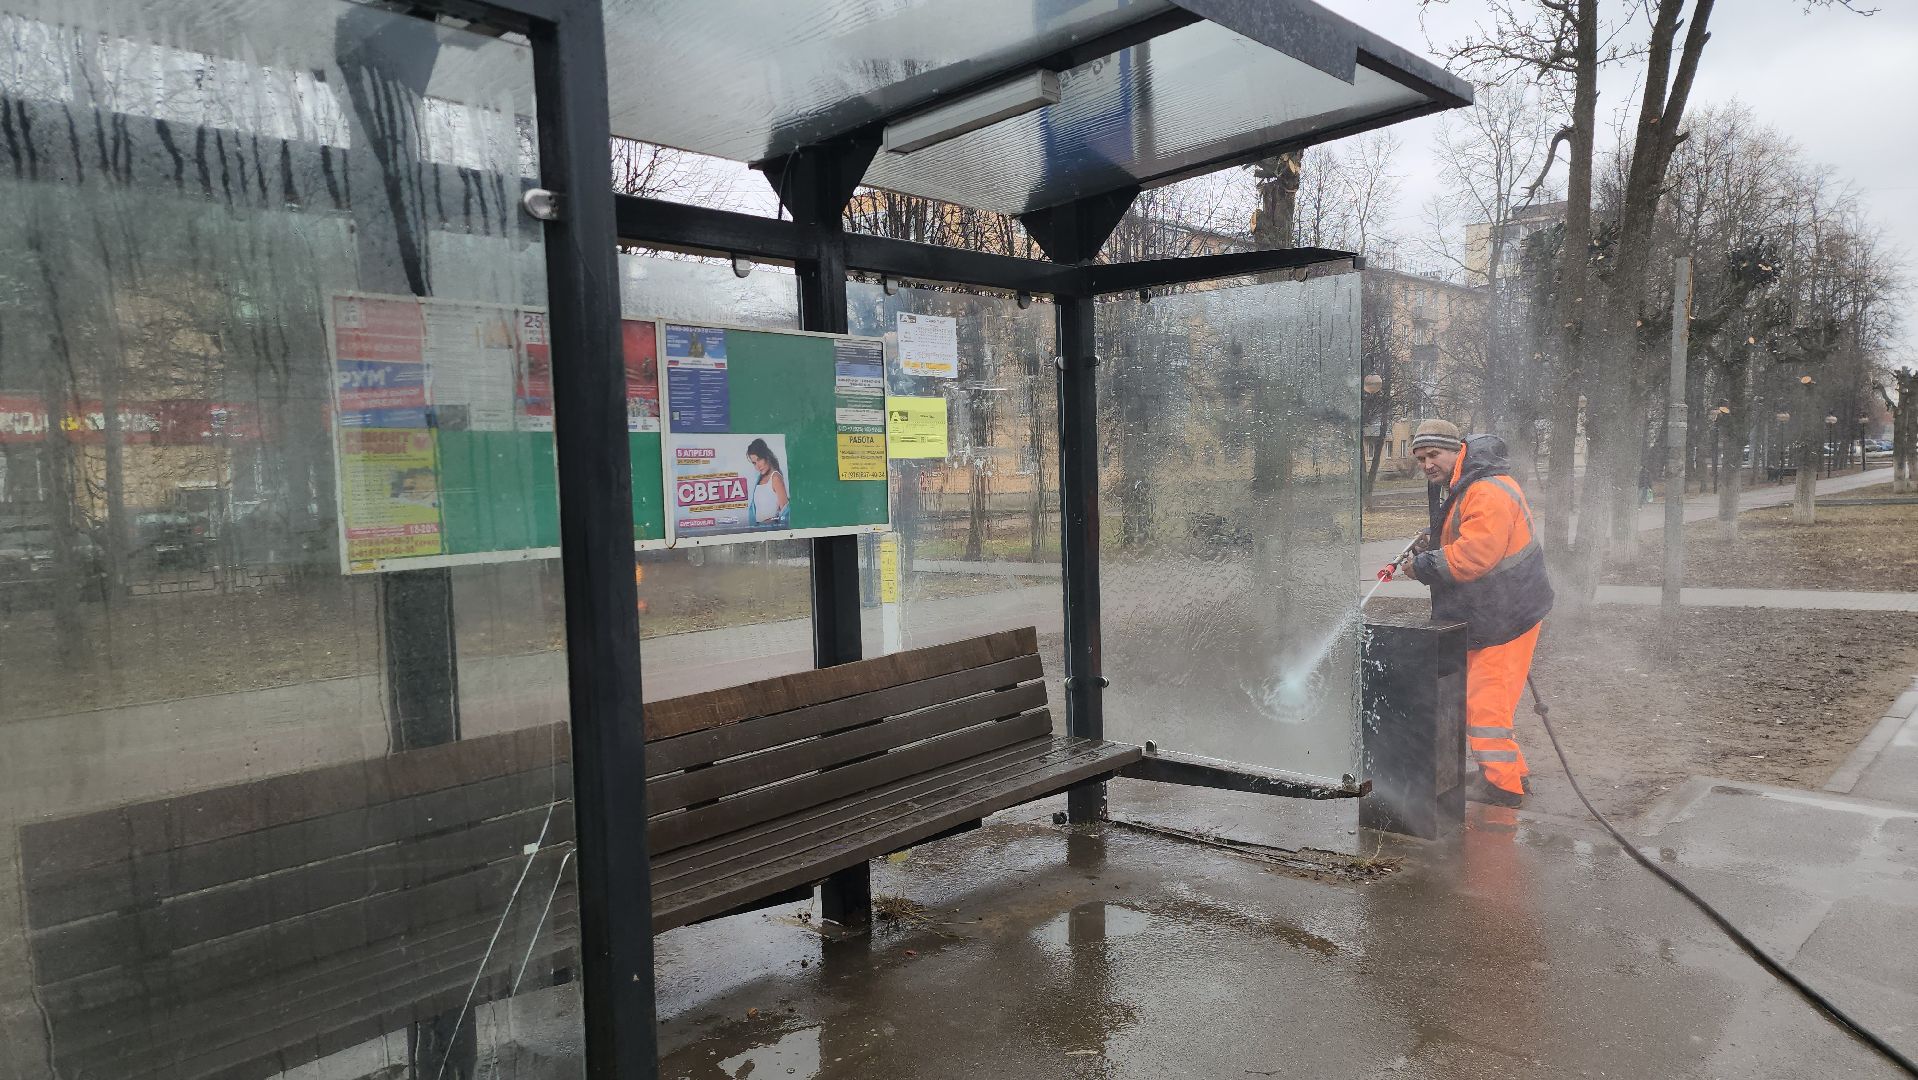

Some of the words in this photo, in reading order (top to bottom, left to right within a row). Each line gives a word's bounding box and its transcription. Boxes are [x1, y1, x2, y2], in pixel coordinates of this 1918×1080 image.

[524, 315, 543, 328] 25
[849, 436, 875, 444] РАБОТА
[683, 449, 714, 457] АПРЕЛЯ
[678, 480, 746, 503] СВЕТА
